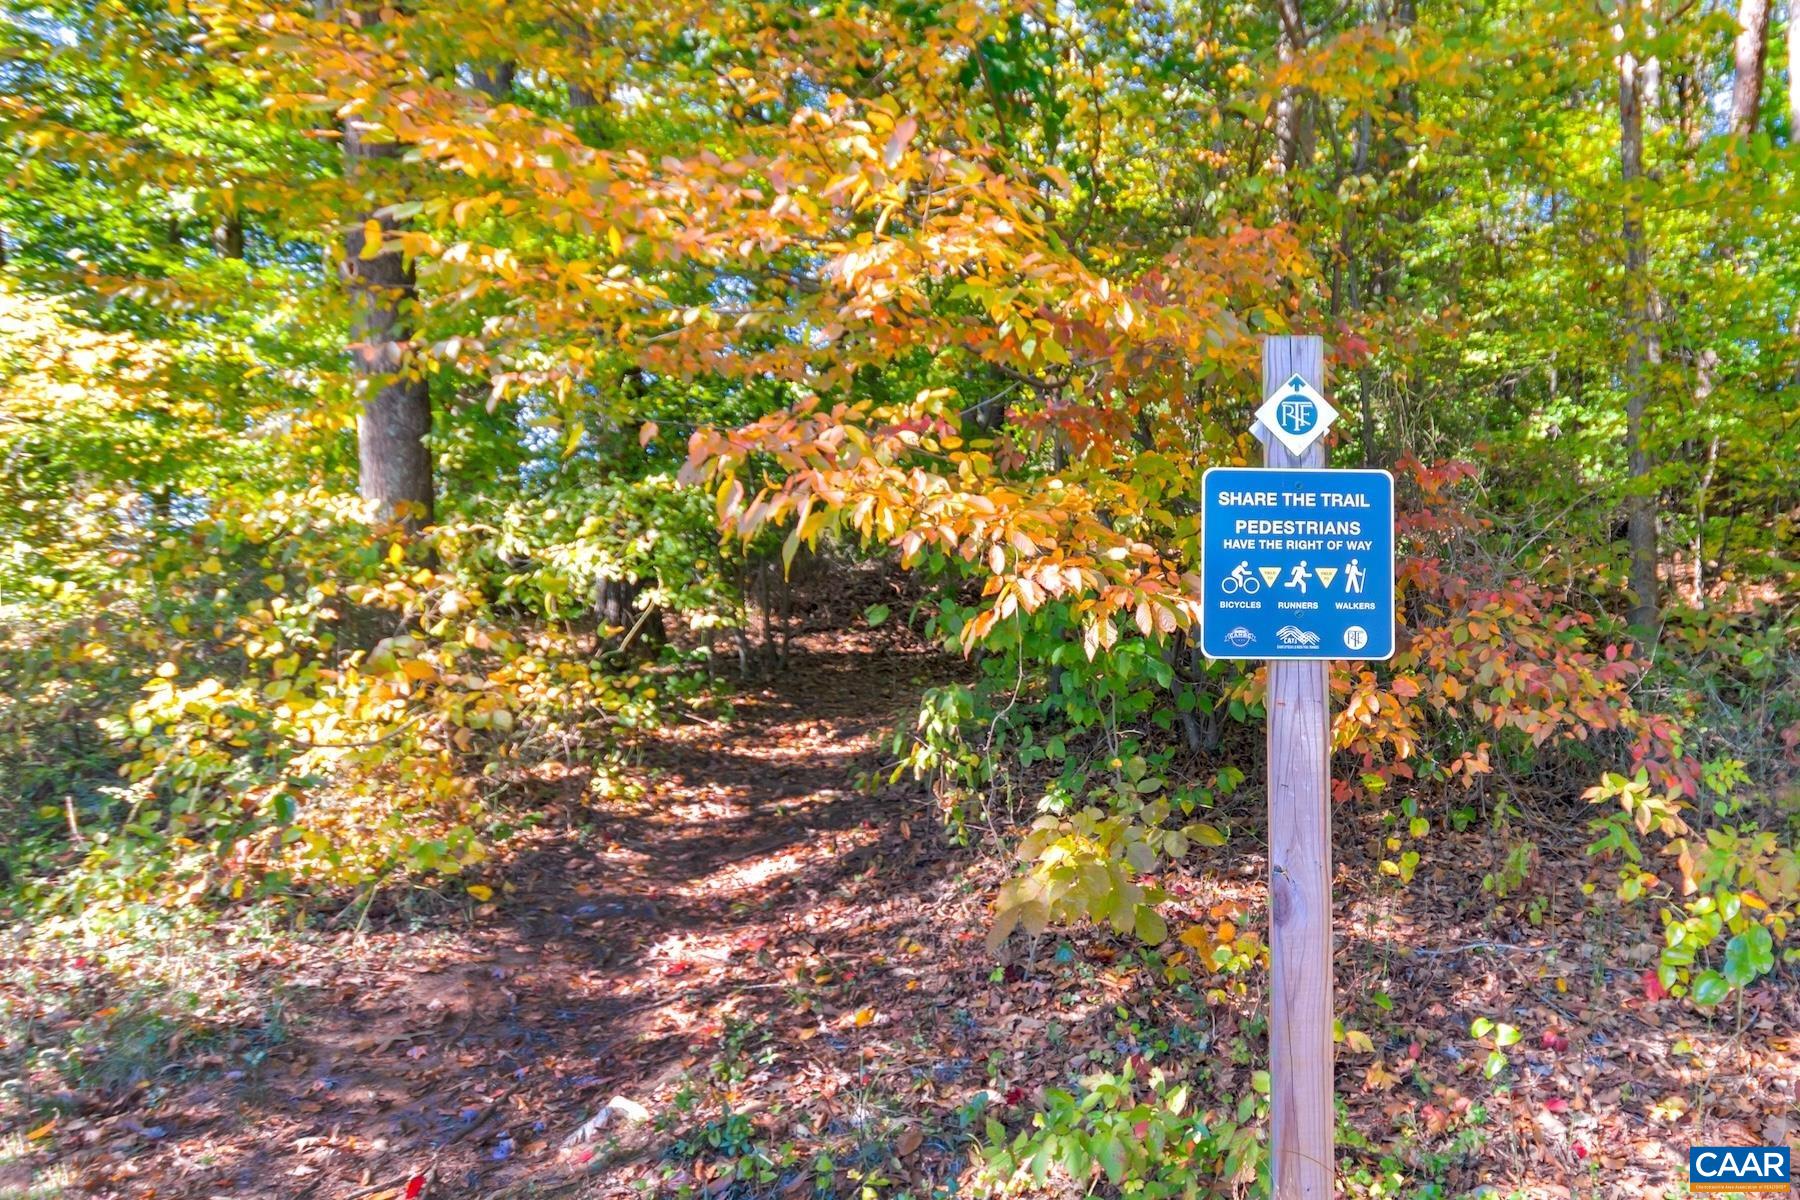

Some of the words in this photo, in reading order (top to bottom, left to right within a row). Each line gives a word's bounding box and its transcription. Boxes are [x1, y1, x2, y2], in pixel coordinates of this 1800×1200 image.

[1218, 491, 1278, 507] SHARE
[1282, 492, 1317, 507] THE
[1321, 492, 1371, 508] TRAIL
[1235, 519, 1361, 536] PEDESTRIANS
[1223, 539, 1256, 550] HAVE
[1258, 539, 1283, 550] THE
[1286, 540, 1324, 550] RIGHT
[1327, 540, 1344, 550] OF
[1346, 540, 1373, 551] WAY
[1219, 601, 1262, 609] BICYCLES
[1277, 601, 1319, 610] RUNNERS
[1335, 602, 1376, 610] WALKERS
